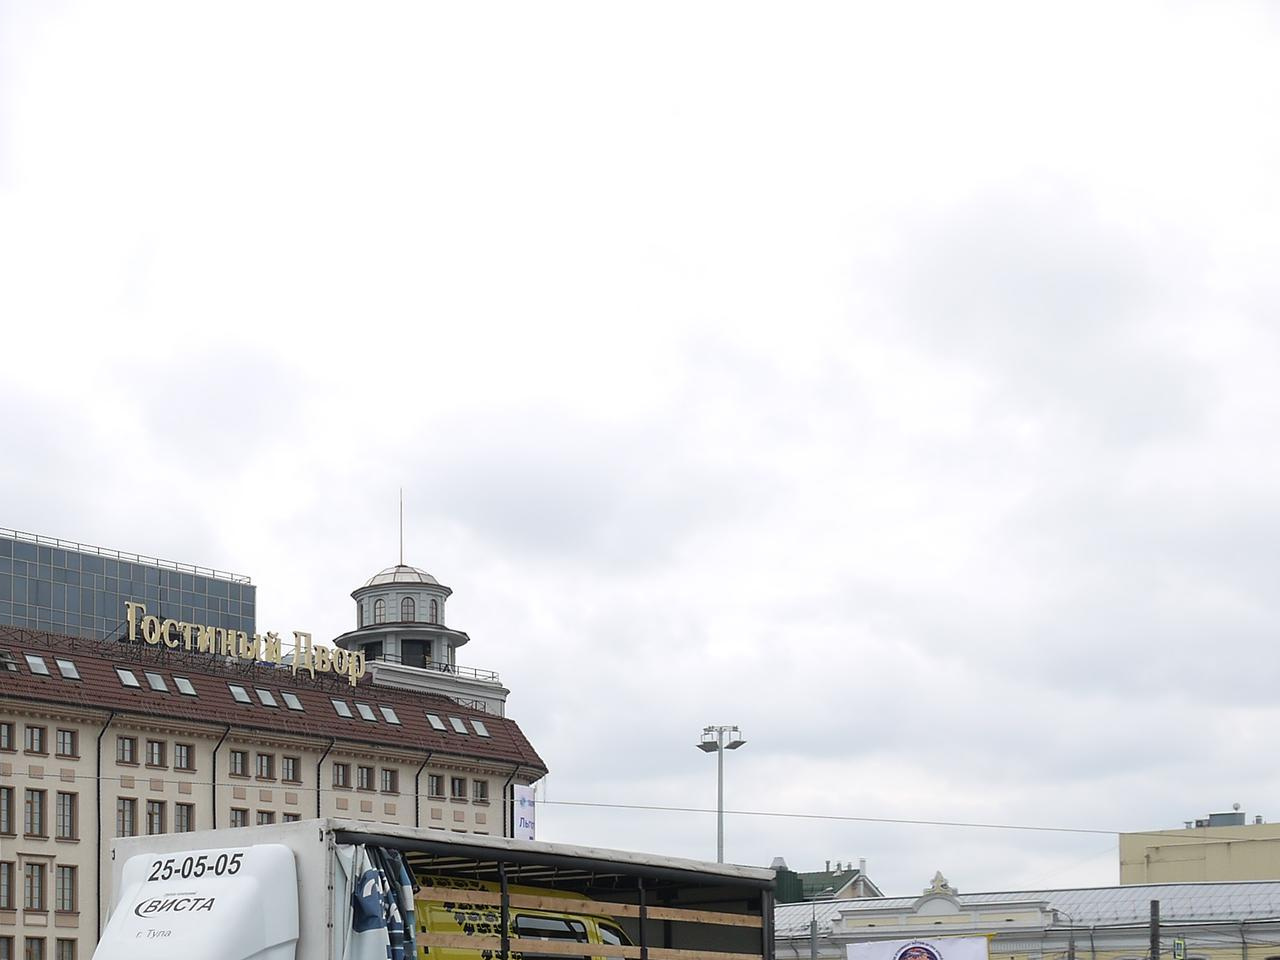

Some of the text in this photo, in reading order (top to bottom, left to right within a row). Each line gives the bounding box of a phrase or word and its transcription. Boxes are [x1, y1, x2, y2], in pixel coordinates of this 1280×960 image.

[124, 600, 367, 688] Гостиный Двор
[148, 853, 244, 882] 25-05-05
[142, 897, 216, 914] ВИСТА
[146, 929, 172, 939] Тула
